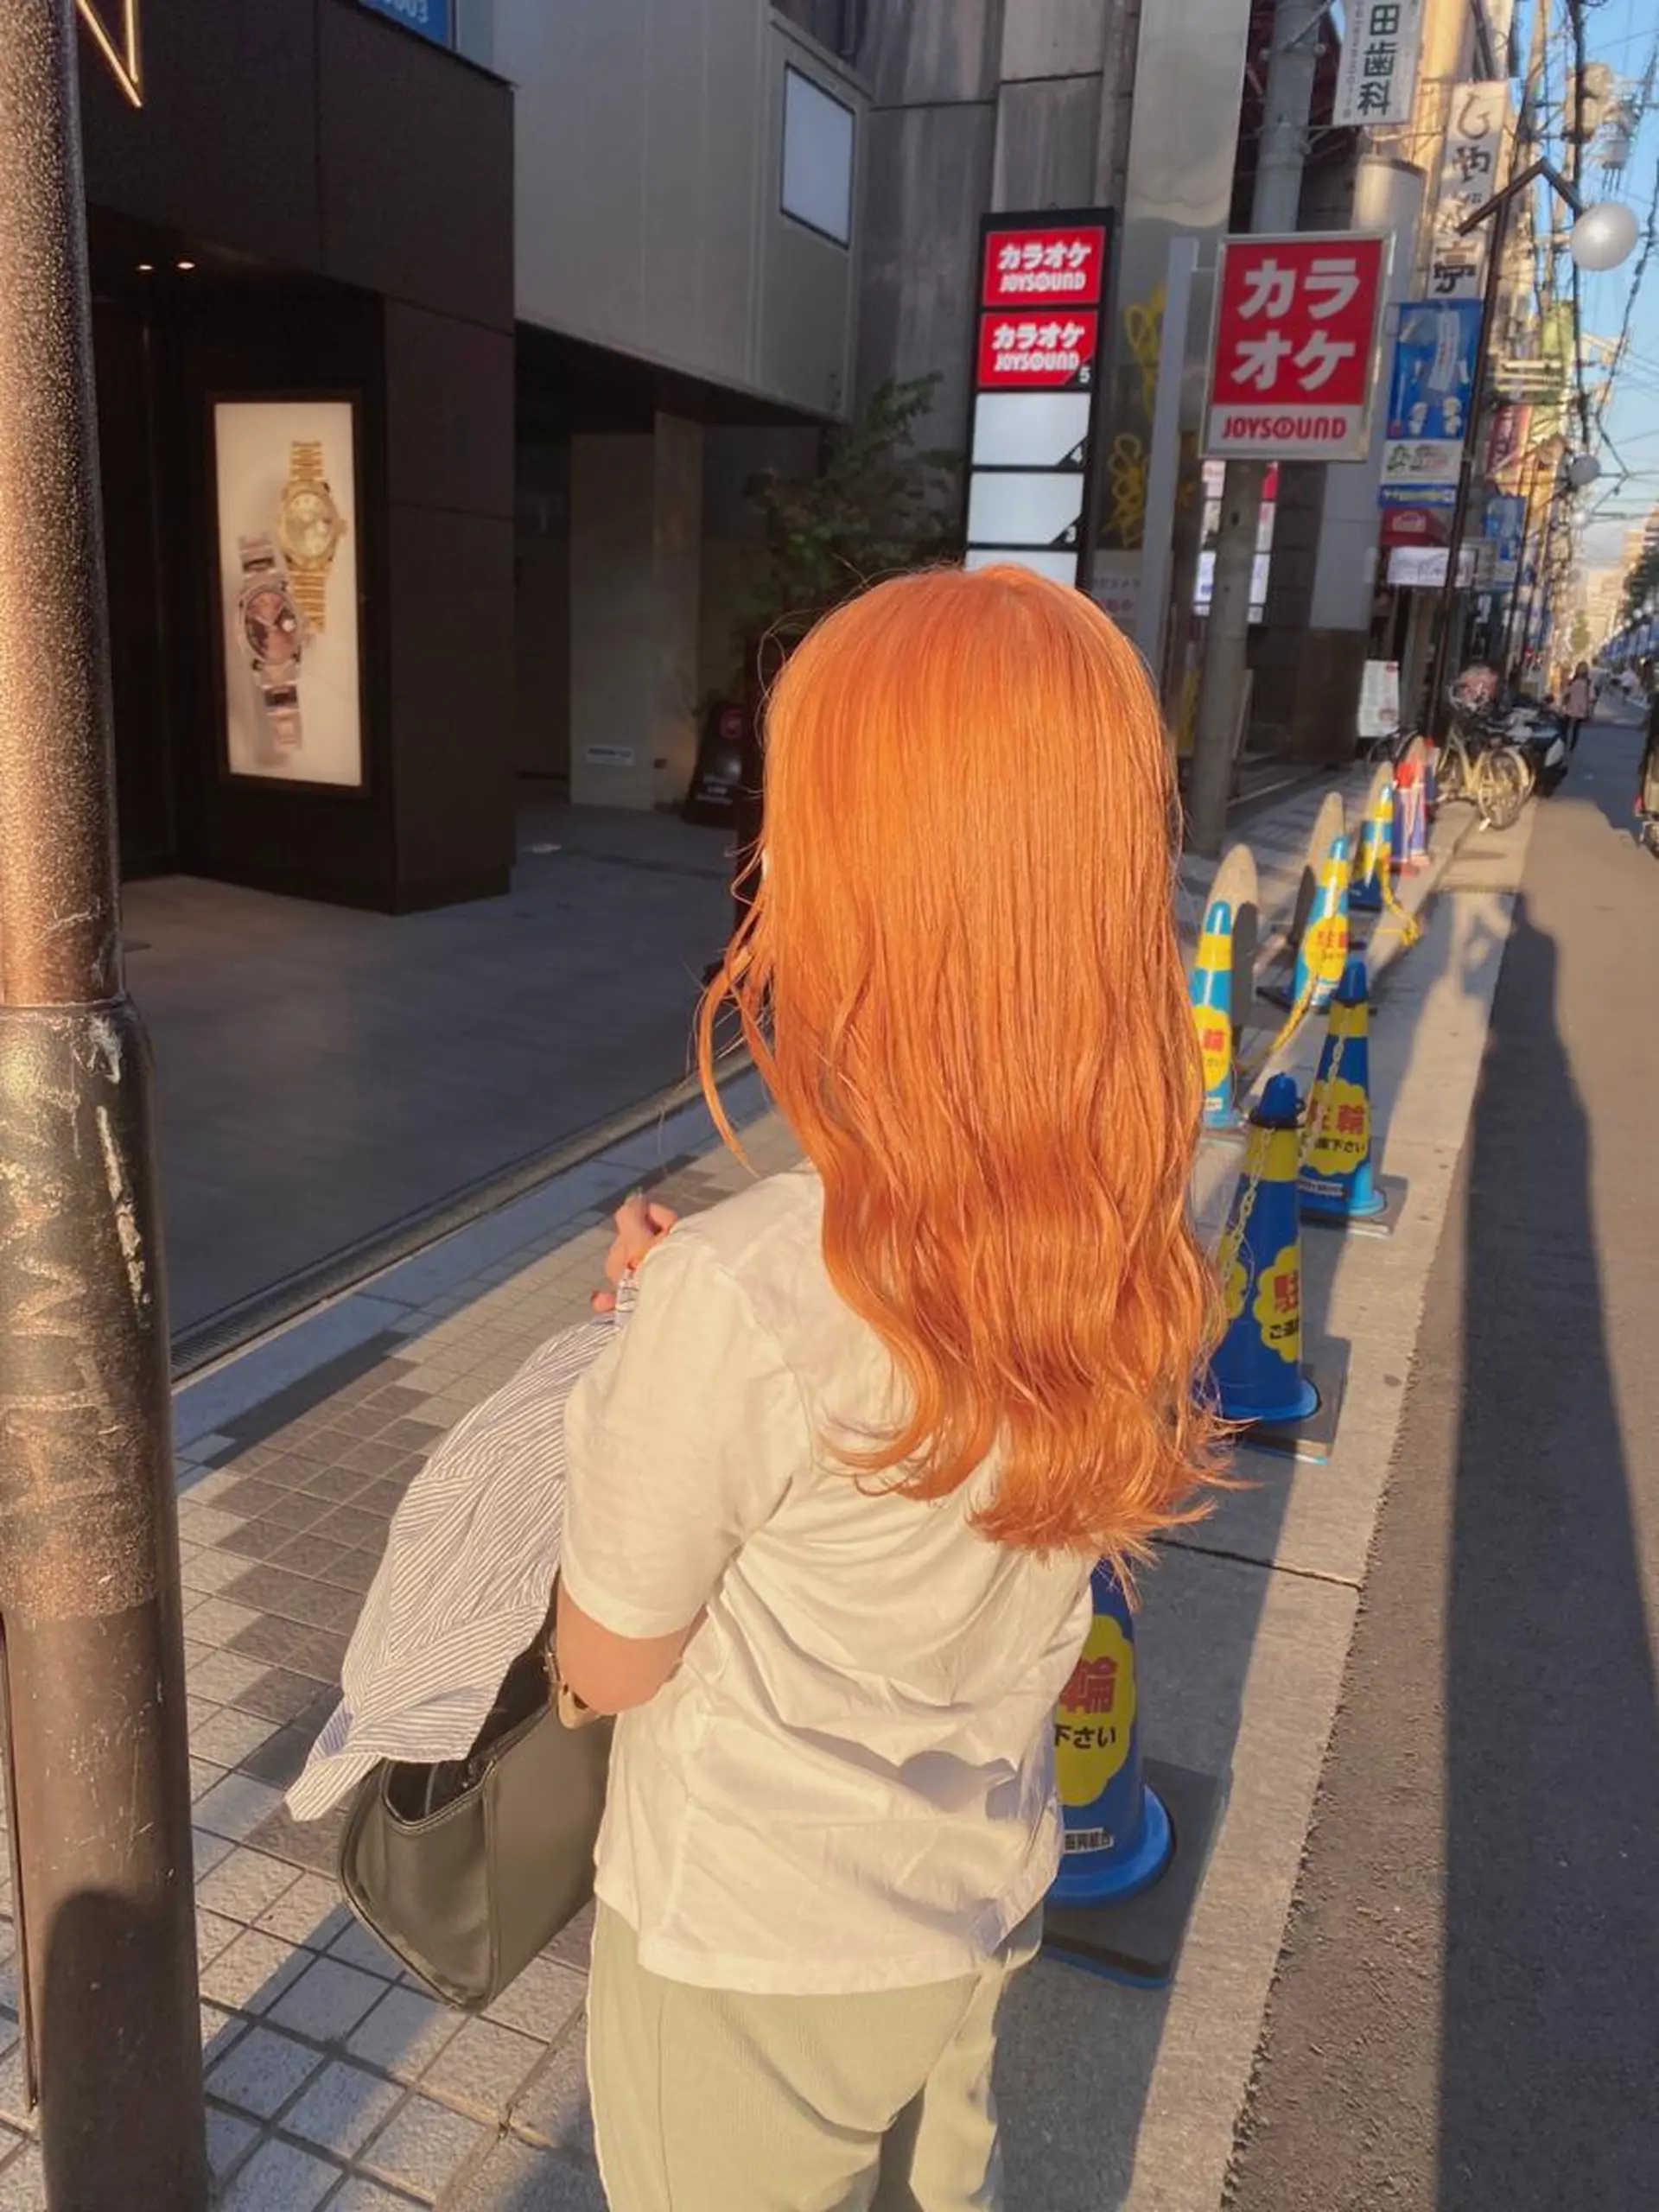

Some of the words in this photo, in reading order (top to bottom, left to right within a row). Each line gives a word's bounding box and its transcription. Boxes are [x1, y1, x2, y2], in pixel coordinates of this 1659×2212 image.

[1357, 4, 1401, 116] 田歯科
[997, 240, 1091, 270] カラオケ
[999, 272, 1086, 293] JOYSOUND
[1237, 258, 1360, 320] カラ
[992, 321, 1085, 350] カラオケ
[995, 352, 1079, 372] JOYSOUND
[1078, 366, 1090, 383] 5
[1230, 329, 1356, 391] オケ
[1222, 416, 1347, 440] JOYSOUND
